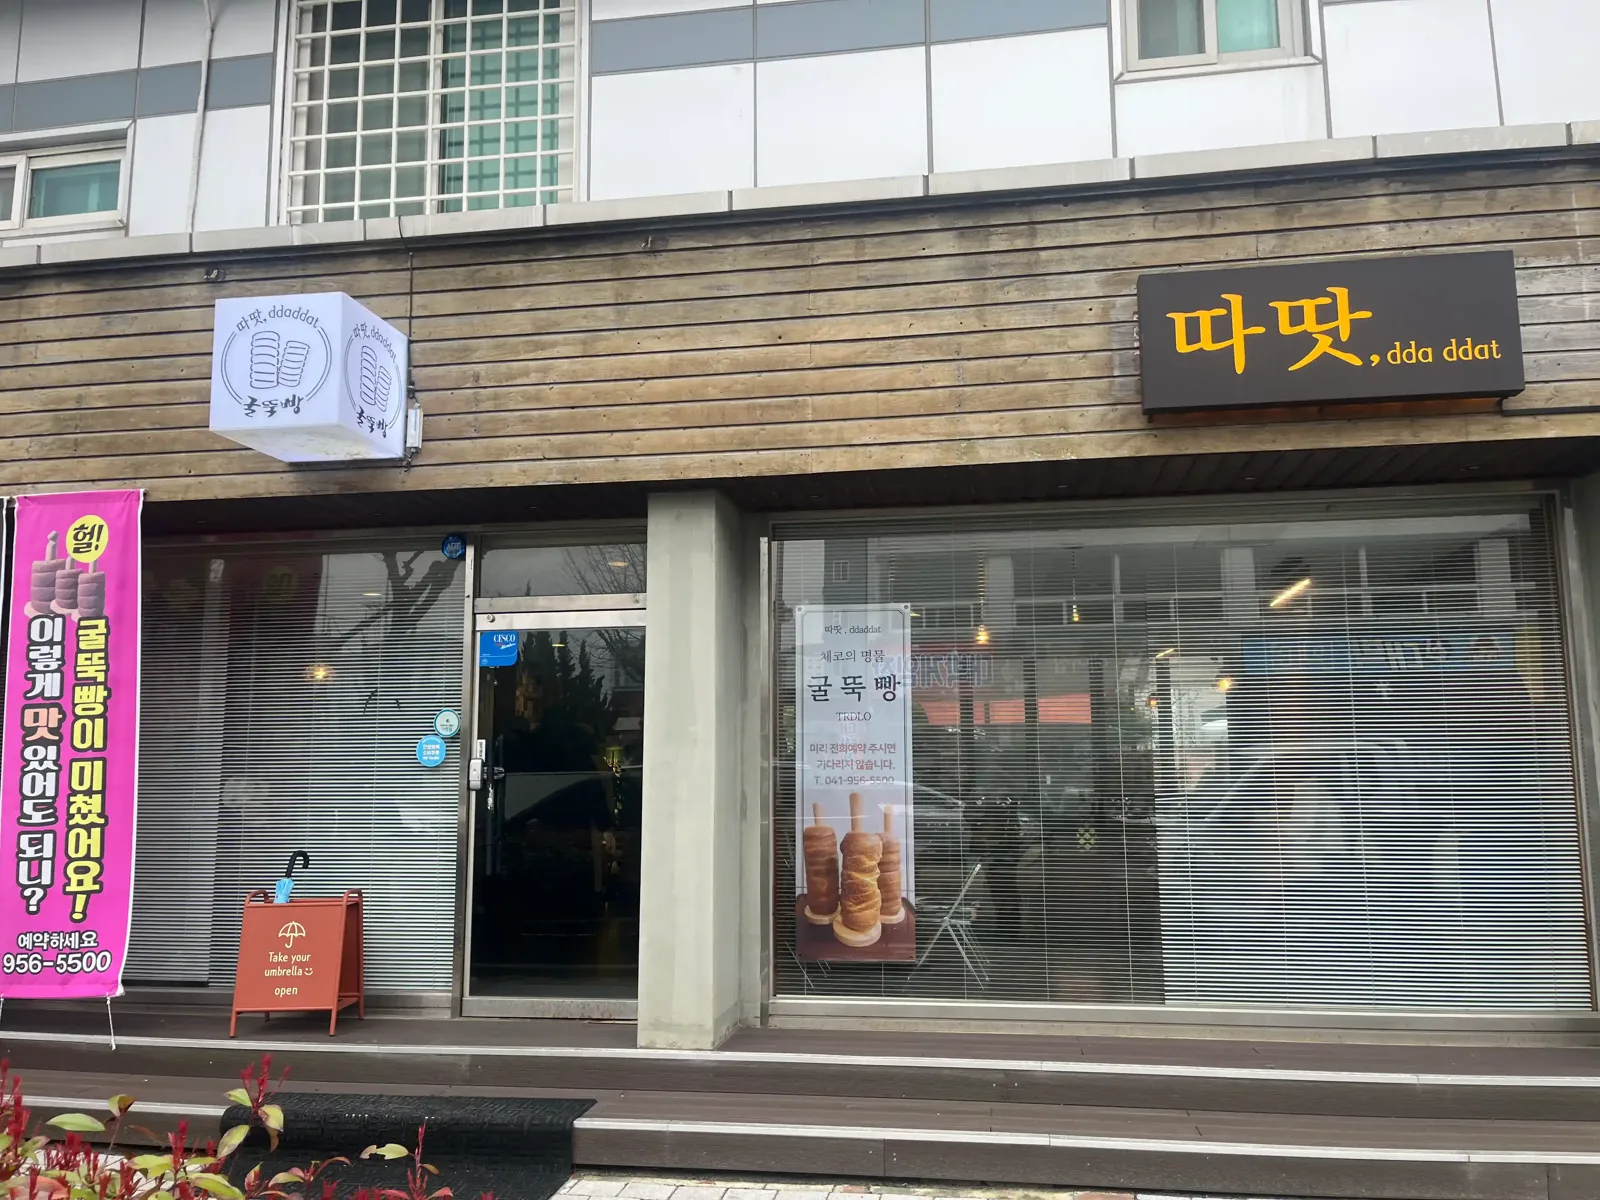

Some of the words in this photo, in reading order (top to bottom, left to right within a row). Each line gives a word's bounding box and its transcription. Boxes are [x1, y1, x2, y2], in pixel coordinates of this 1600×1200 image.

[268, 305, 320, 329] ddaddat
[1386, 340, 1433, 365] dda
[1443, 337, 1502, 362] ddat
[72, 523, 104, 554] 헐!
[25, 616, 64, 699] 이렇게
[820, 649, 857, 663] 체코의
[861, 649, 885, 663] 명물
[71, 618, 109, 750] 굴뚝빵이
[836, 711, 872, 722] TRDLO
[809, 743, 828, 754] 미리
[868, 743, 896, 754] 주시면
[19, 707, 64, 824] 맛있어도
[817, 759, 853, 770] 기다리지
[856, 759, 896, 771] 않습니다.
[824, 775, 895, 786] 041-956-5500
[65, 760, 106, 920] 미쳤어요!
[18, 832, 54, 912] 되니?
[17, 930, 99, 951] 예약하세요
[2, 950, 112, 974] 956-5500
[268, 951, 288, 963] Take
[291, 953, 311, 965] your
[264, 965, 303, 977] umbrella
[274, 985, 298, 997] open
